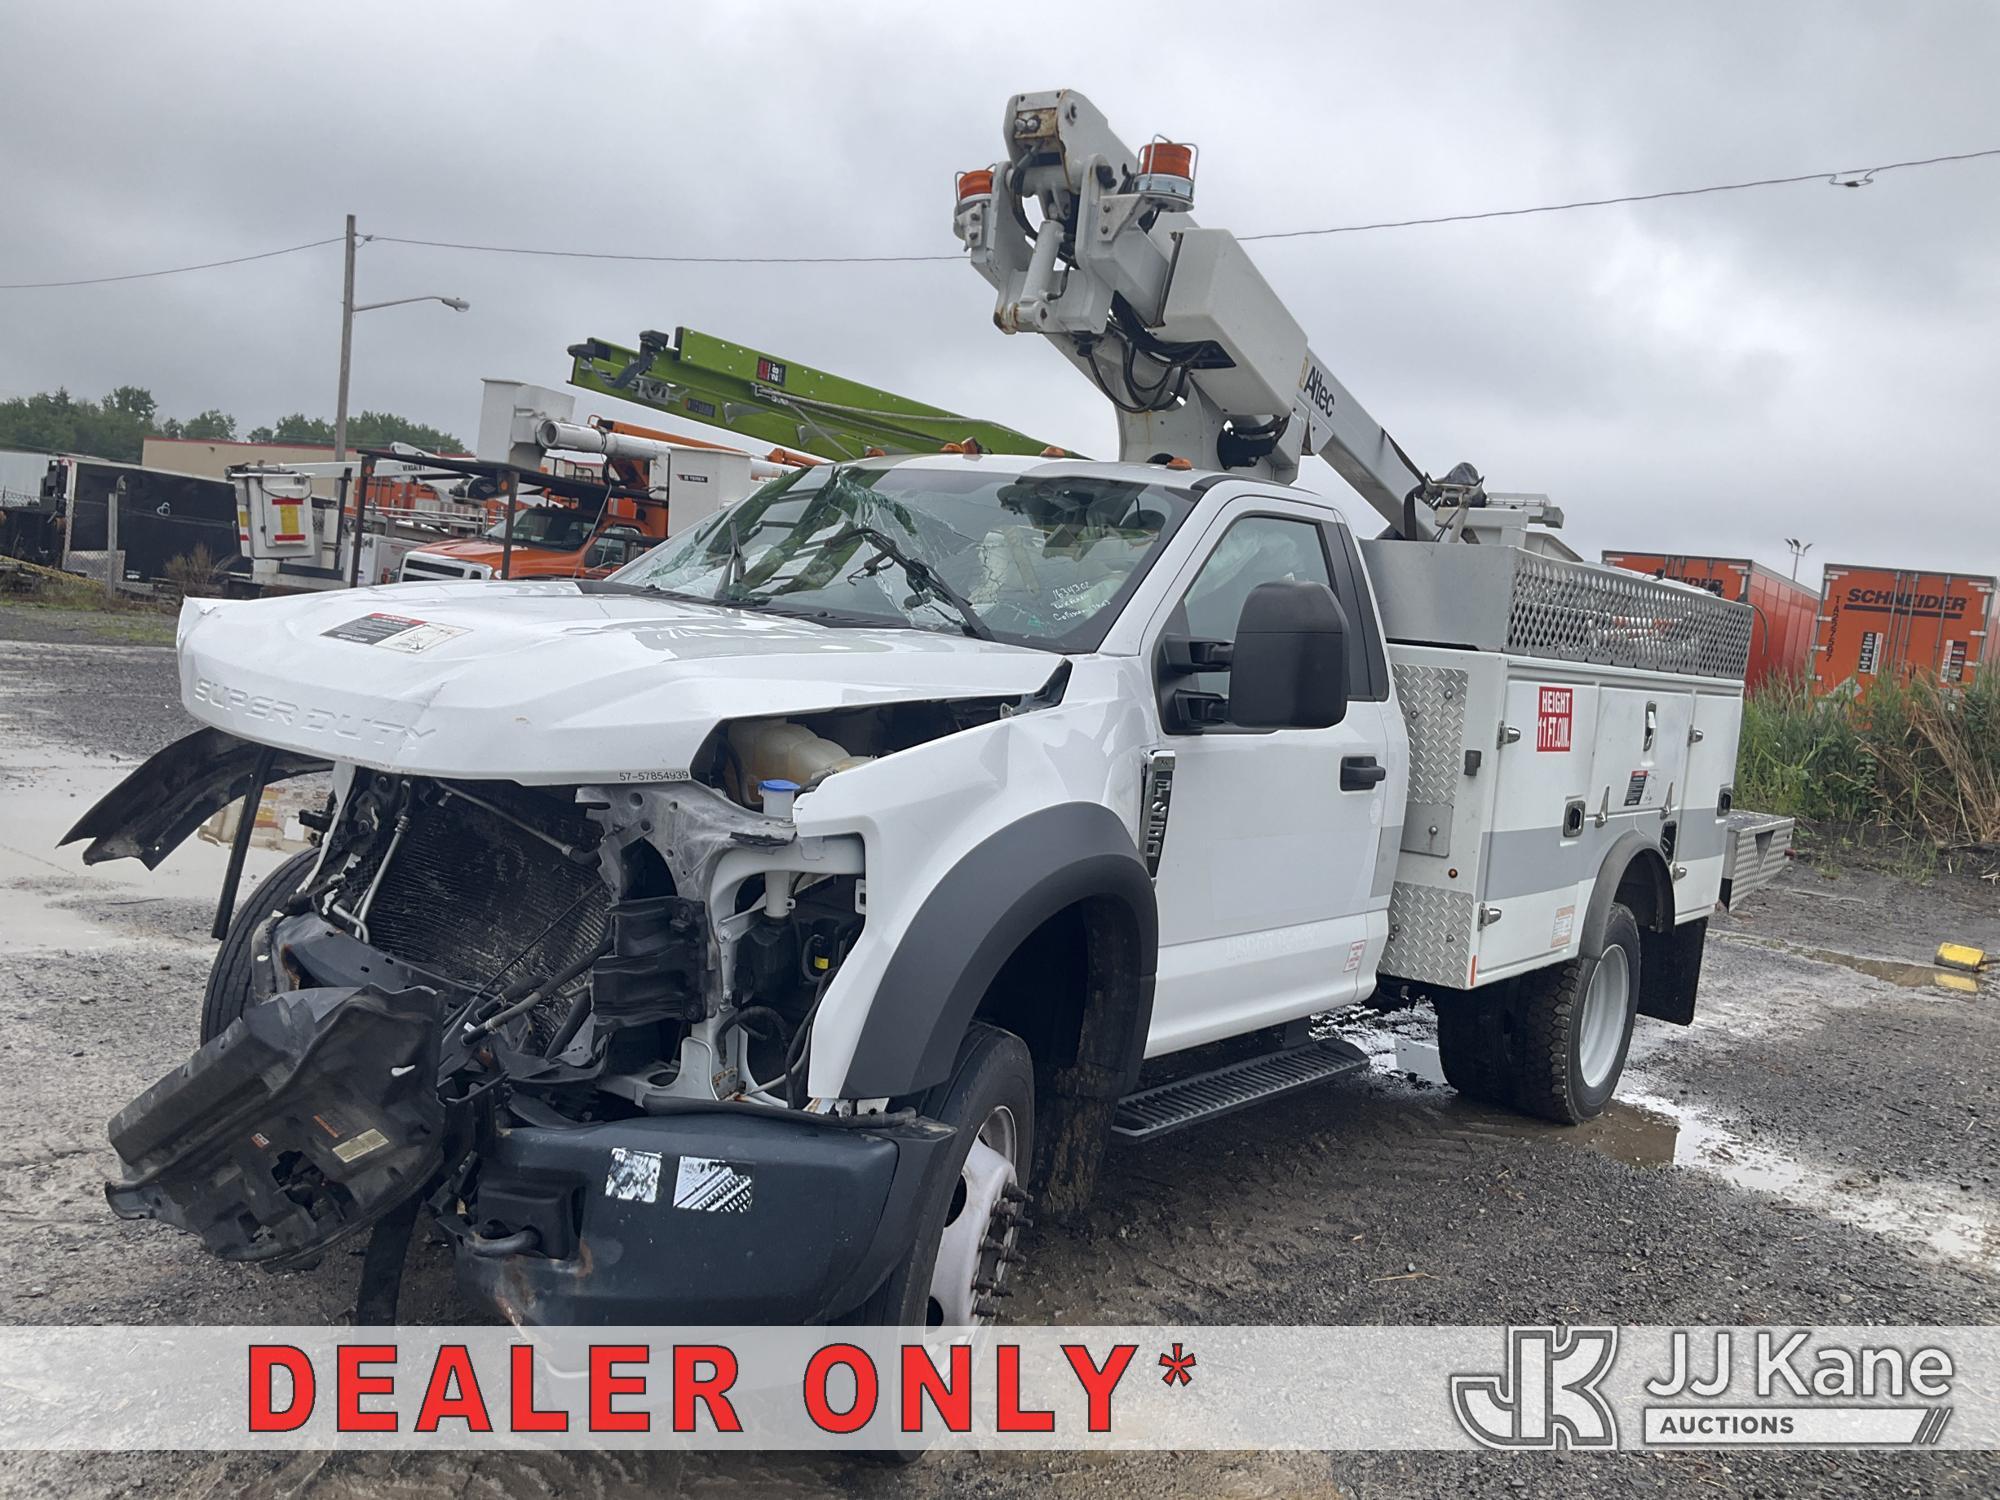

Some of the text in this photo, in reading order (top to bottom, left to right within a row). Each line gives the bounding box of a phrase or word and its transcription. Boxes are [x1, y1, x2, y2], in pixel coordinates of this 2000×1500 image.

[1304, 366, 1335, 417] Altec
[1847, 588, 1967, 611] SCHNEIDER
[195, 678, 436, 750] SUPER DUTY
[1541, 690, 1570, 714] HEIGHT
[1538, 717, 1547, 747] 11
[618, 770, 689, 781] 57-57854939
